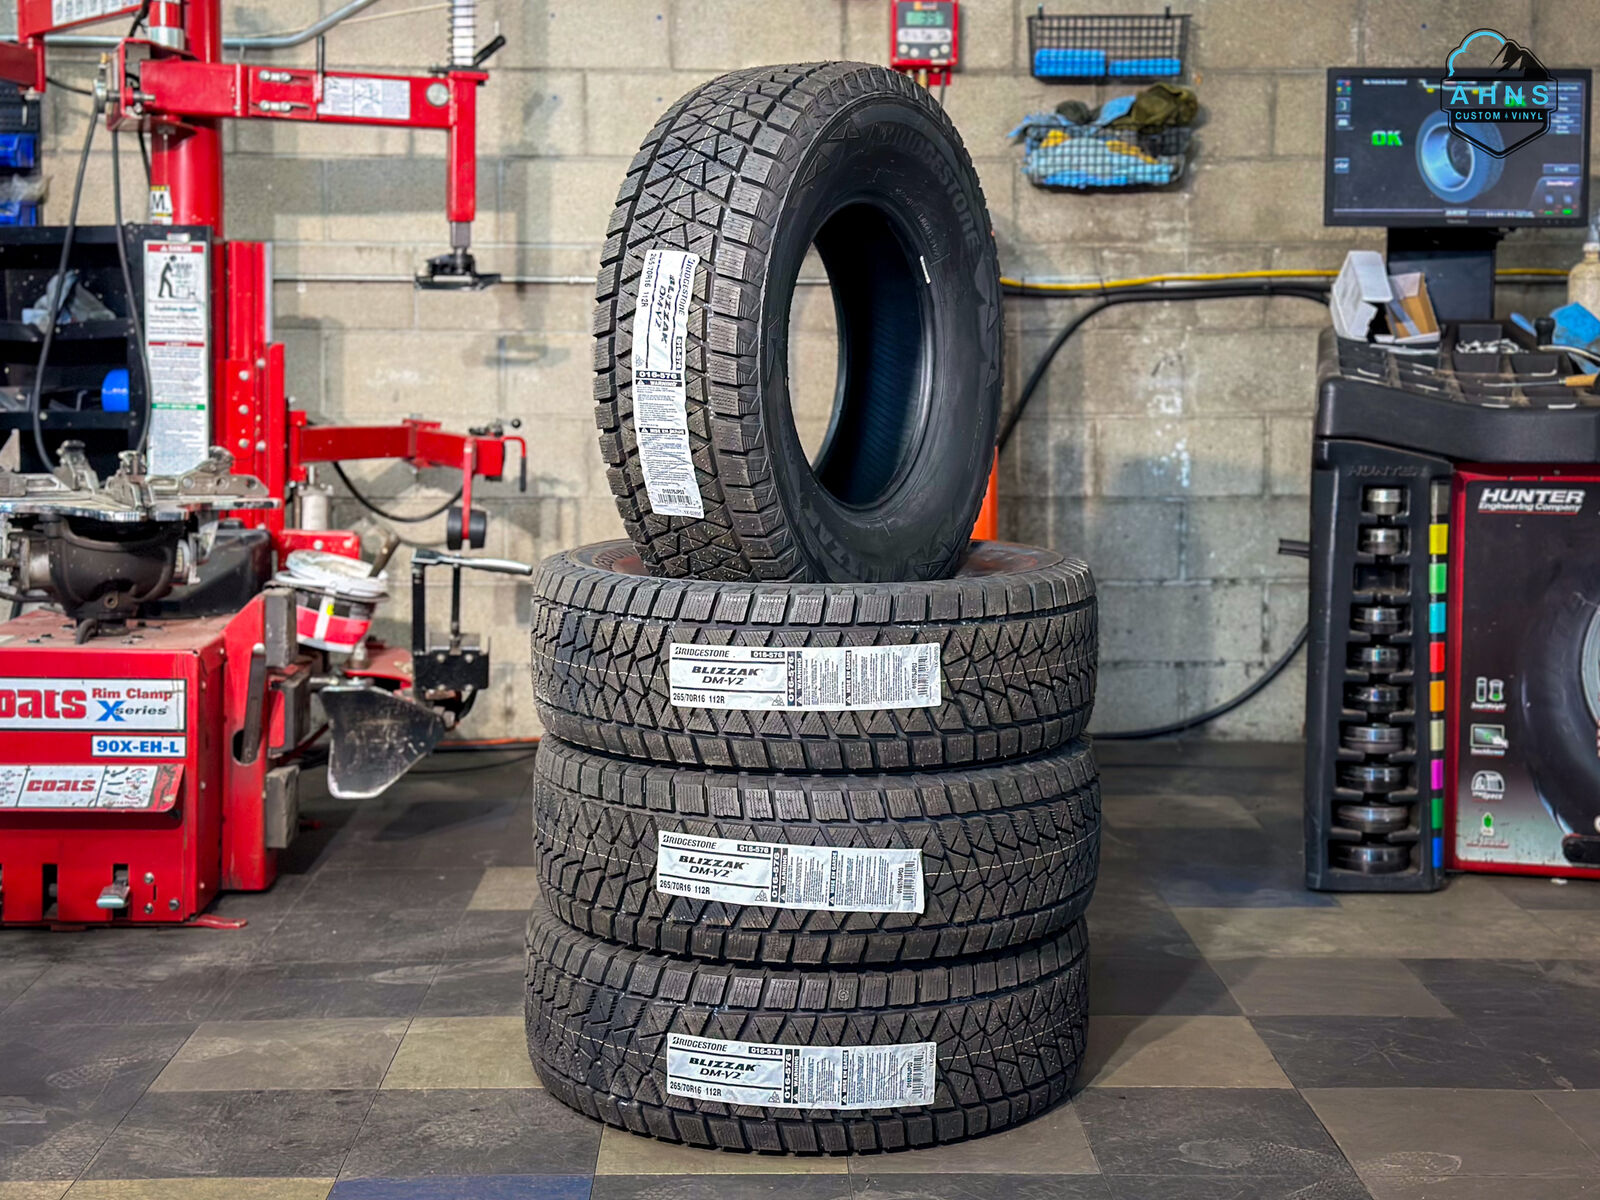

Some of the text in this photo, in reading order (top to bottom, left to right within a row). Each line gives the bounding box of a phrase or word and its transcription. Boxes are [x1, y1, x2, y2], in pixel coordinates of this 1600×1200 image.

[1371, 130, 1404, 147] OK
[640, 291, 649, 308] 112R
[661, 274, 676, 345] BLIZZAK
[1481, 487, 1586, 504] HUNTER
[1478, 502, 1582, 513] Engineering Company
[674, 646, 730, 658] BRIDGESTONE
[752, 651, 783, 659] 016-576
[691, 665, 760, 676] BLIZZAK
[702, 676, 745, 686] DM-V2
[787, 655, 795, 702] 016-576
[92, 687, 173, 701] Rim Clamp
[672, 692, 725, 704] 265/70R16 112R
[97, 740, 179, 753] 90X-EH-L
[662, 834, 717, 850] BRIDGESTONE
[739, 845, 769, 854] 016-576
[678, 855, 745, 870] BLIZZAK
[689, 866, 730, 878] DM-V2
[771, 852, 780, 898] 016-576
[659, 880, 711, 895] 265/70R16 112R
[672, 1036, 728, 1052] BRIDGESTONE
[750, 1047, 781, 1055] 016-576
[688, 1057, 757, 1071] BLIZZAK
[699, 1068, 743, 1080] DM-V2
[784, 1053, 792, 1099] 016-576
[669, 1081, 722, 1097] 265/70R16 112R
